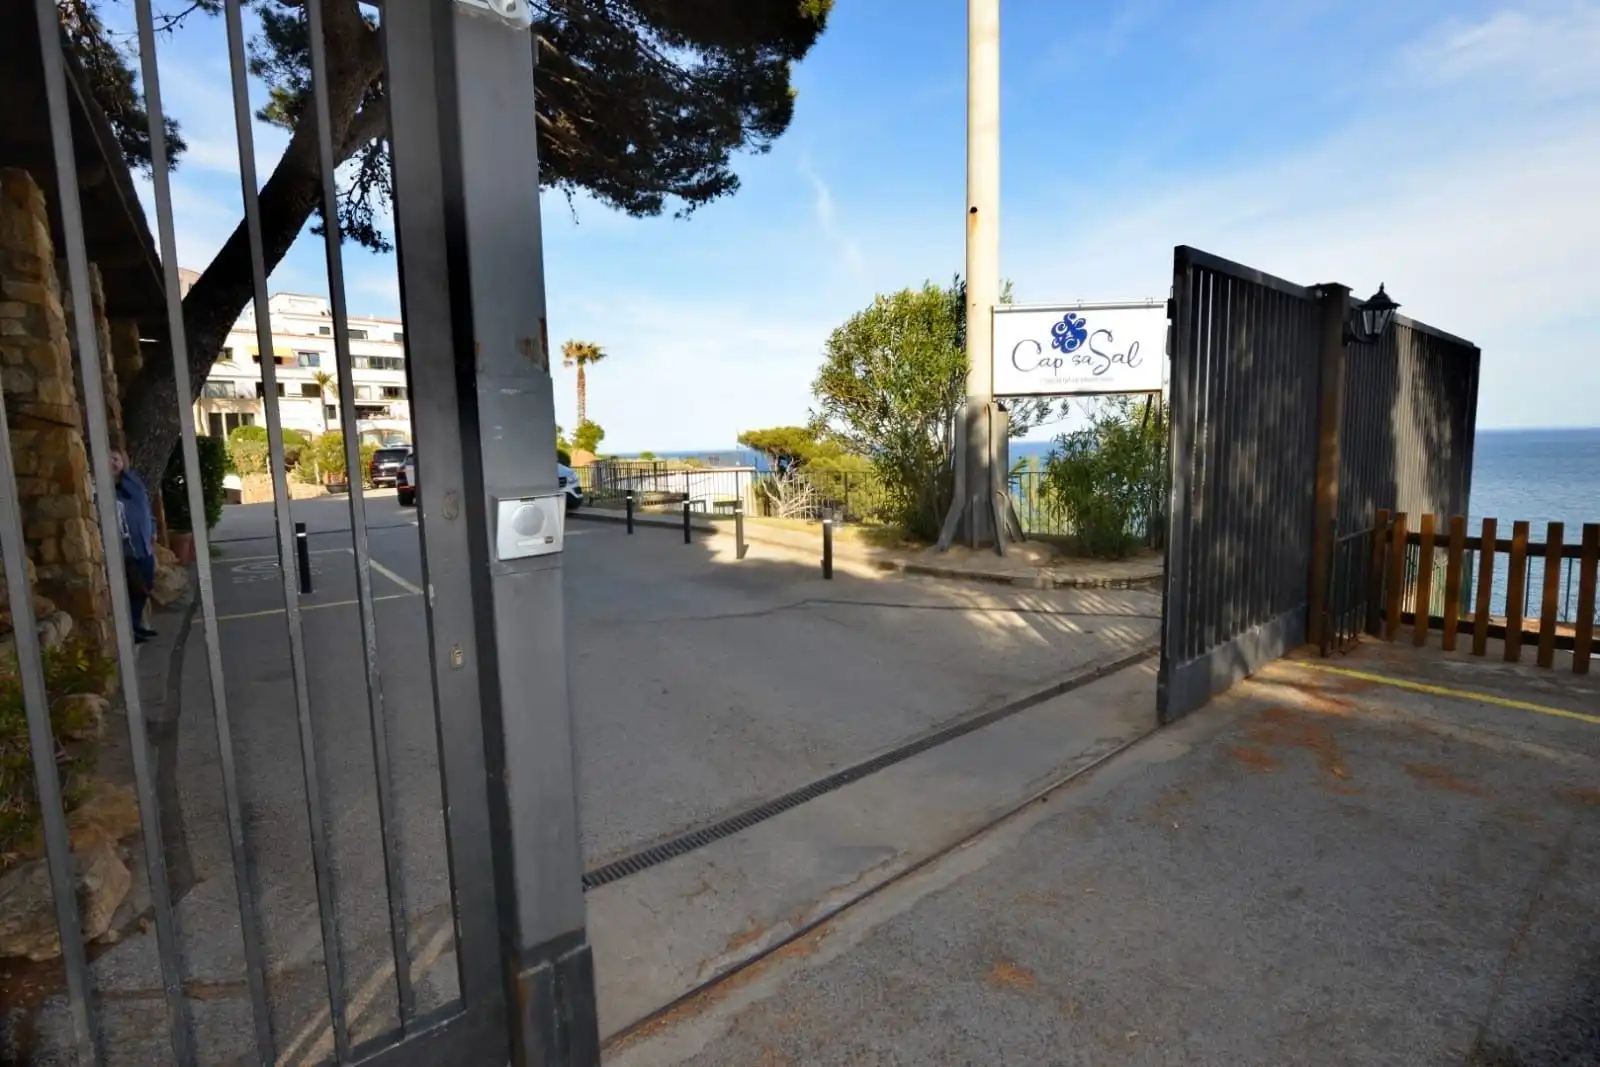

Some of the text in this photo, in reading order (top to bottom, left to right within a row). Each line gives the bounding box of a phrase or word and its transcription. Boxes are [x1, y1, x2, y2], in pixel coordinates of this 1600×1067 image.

[1012, 329, 1143, 376] Cap sa Sal
